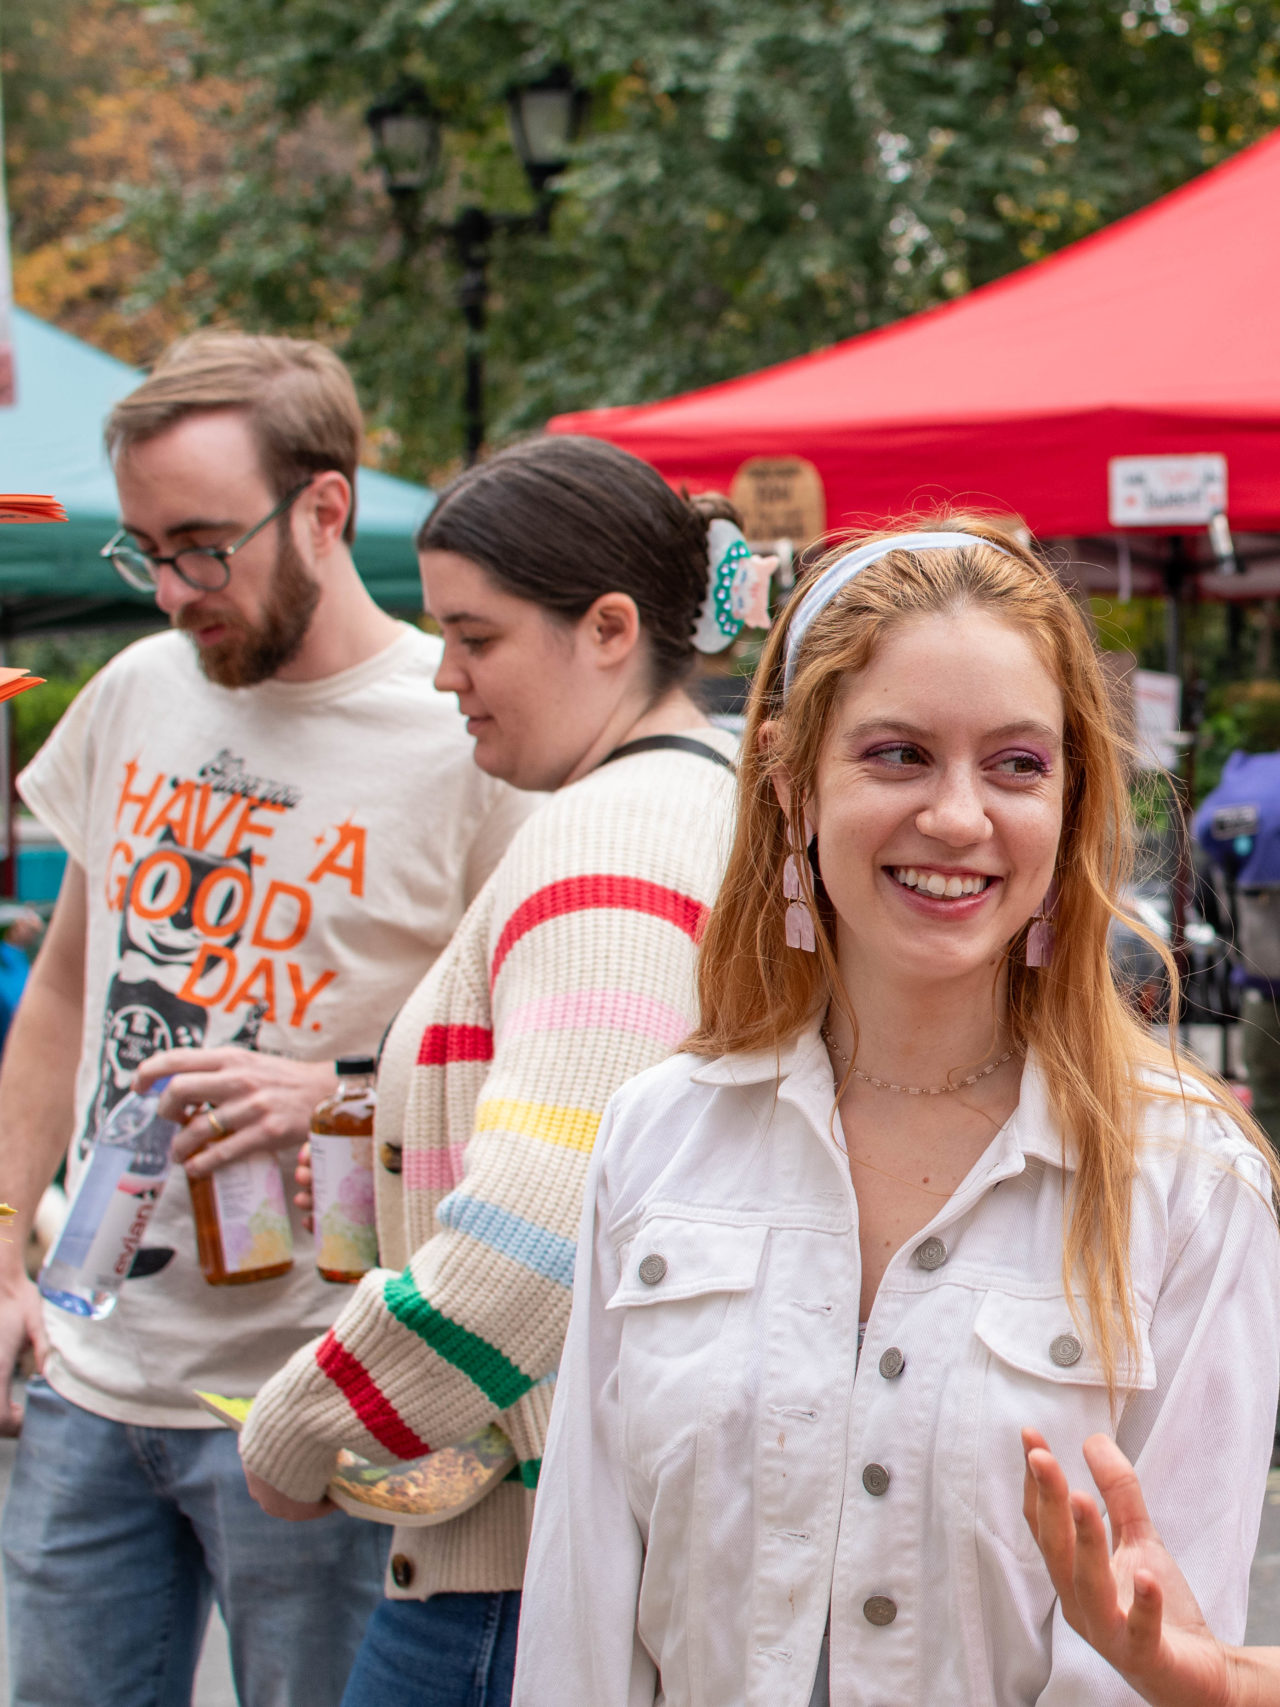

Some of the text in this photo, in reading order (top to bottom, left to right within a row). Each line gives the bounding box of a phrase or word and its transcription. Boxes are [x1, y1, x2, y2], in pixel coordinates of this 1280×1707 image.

[114, 758, 288, 867] HAVE
[306, 819, 367, 898] A
[105, 840, 313, 952] GOOD
[176, 942, 339, 1034] DAY.
[113, 1203, 153, 1276] evian
